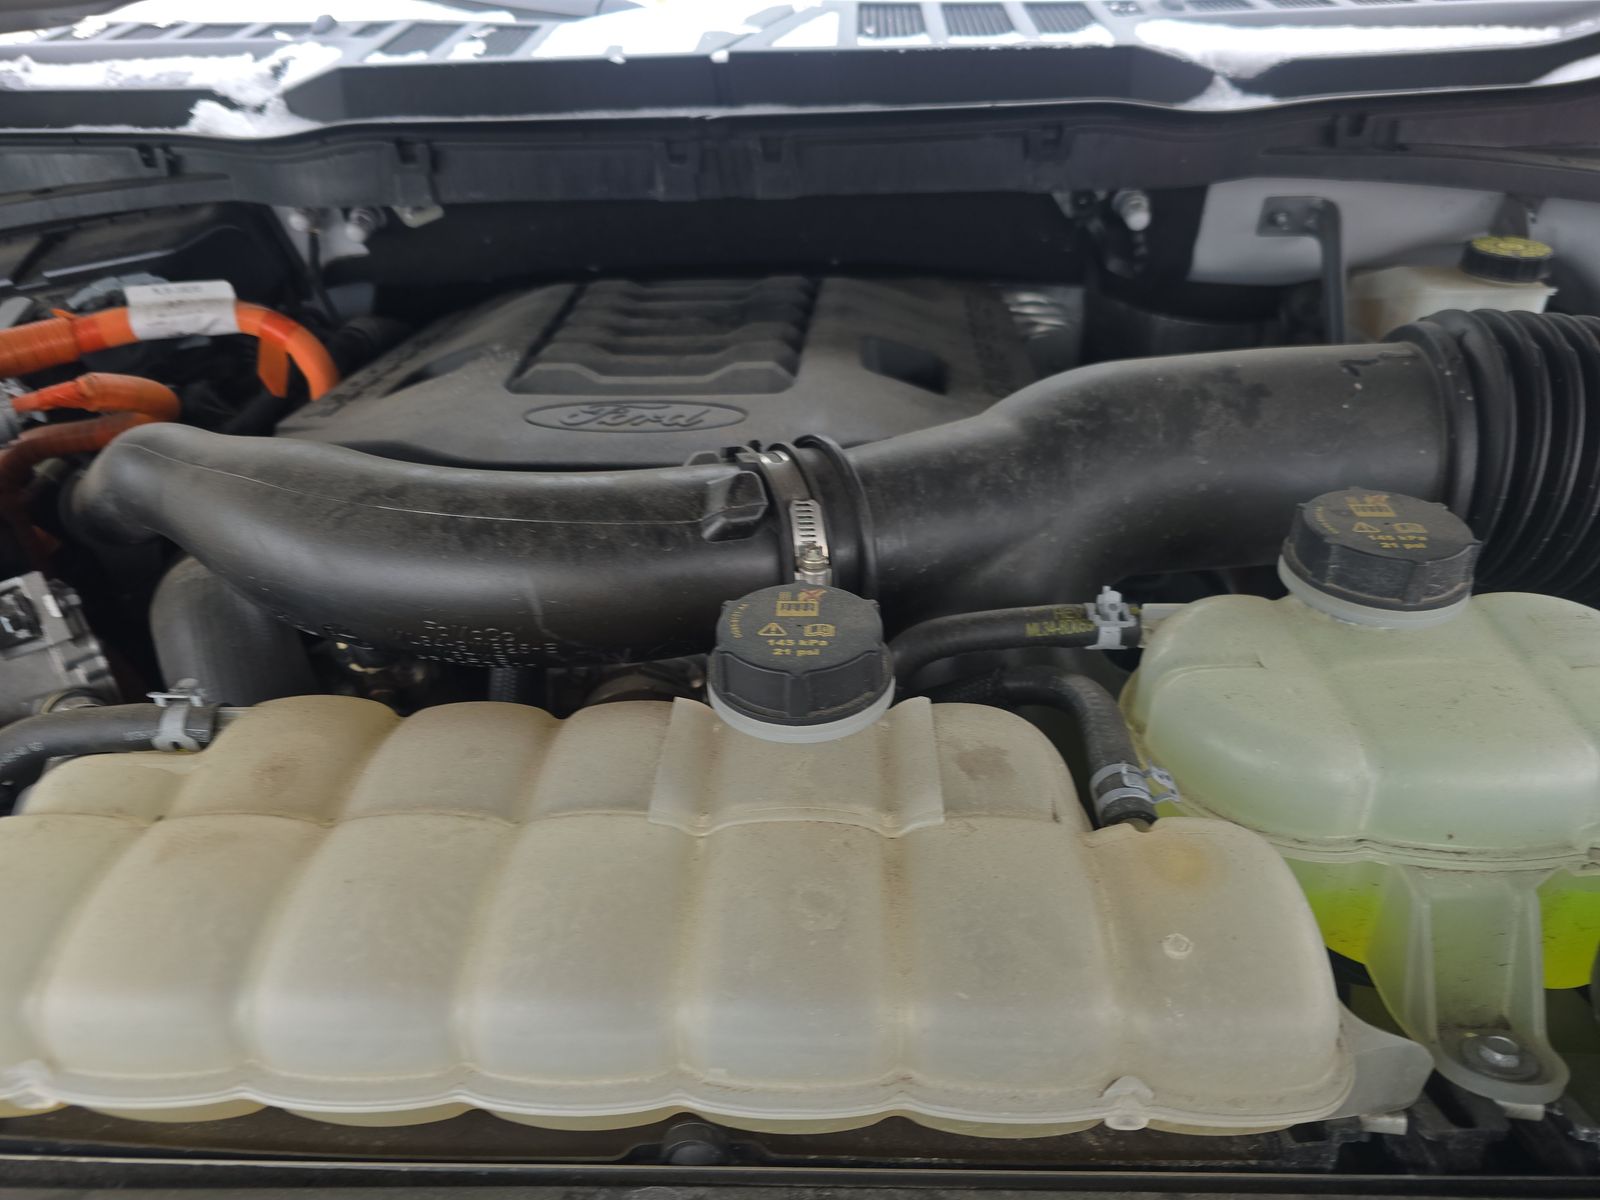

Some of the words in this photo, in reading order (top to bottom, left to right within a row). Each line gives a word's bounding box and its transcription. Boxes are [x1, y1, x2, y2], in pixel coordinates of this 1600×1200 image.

[560, 403, 711, 428] Ford
[772, 648, 793, 656] 21
[796, 648, 820, 657] psi
